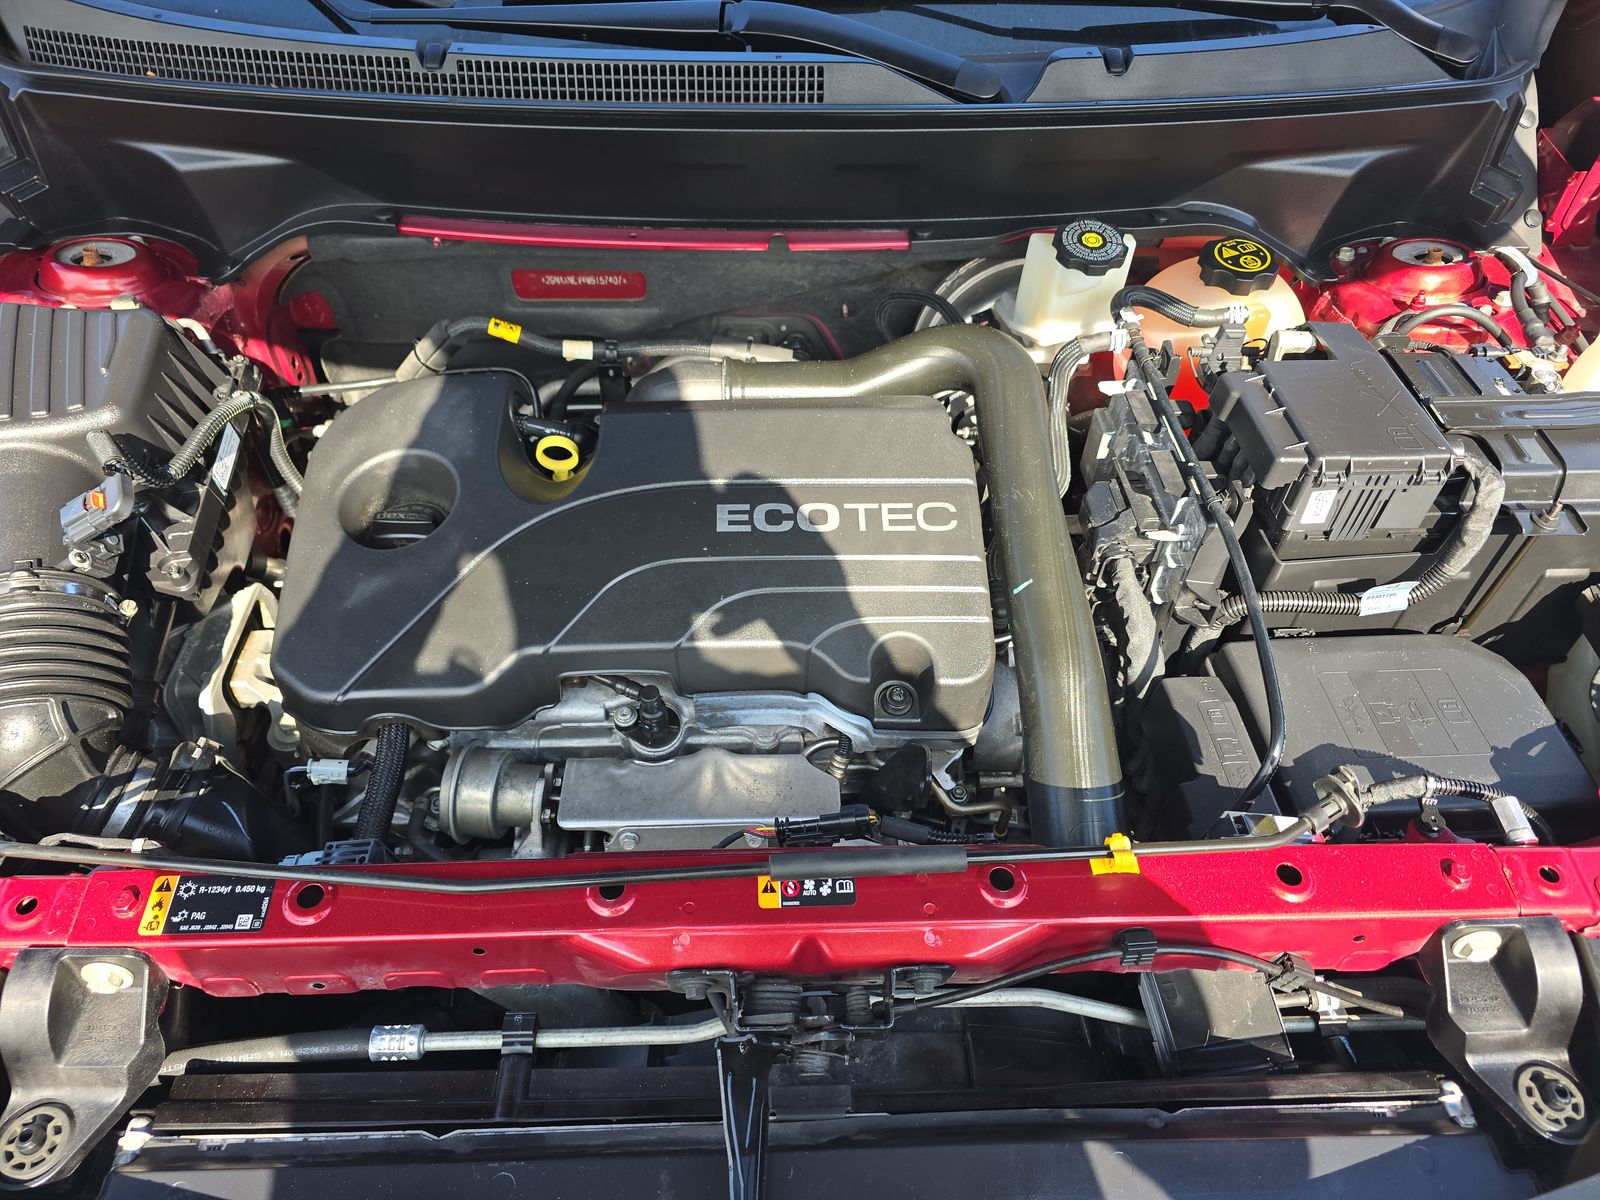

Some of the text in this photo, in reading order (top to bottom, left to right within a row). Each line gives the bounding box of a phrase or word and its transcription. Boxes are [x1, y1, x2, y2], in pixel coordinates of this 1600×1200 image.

[716, 502, 958, 533] ECOTEC
[199, 885, 266, 894] R-1234yf 0.450 kg
[190, 912, 206, 920] PAG
